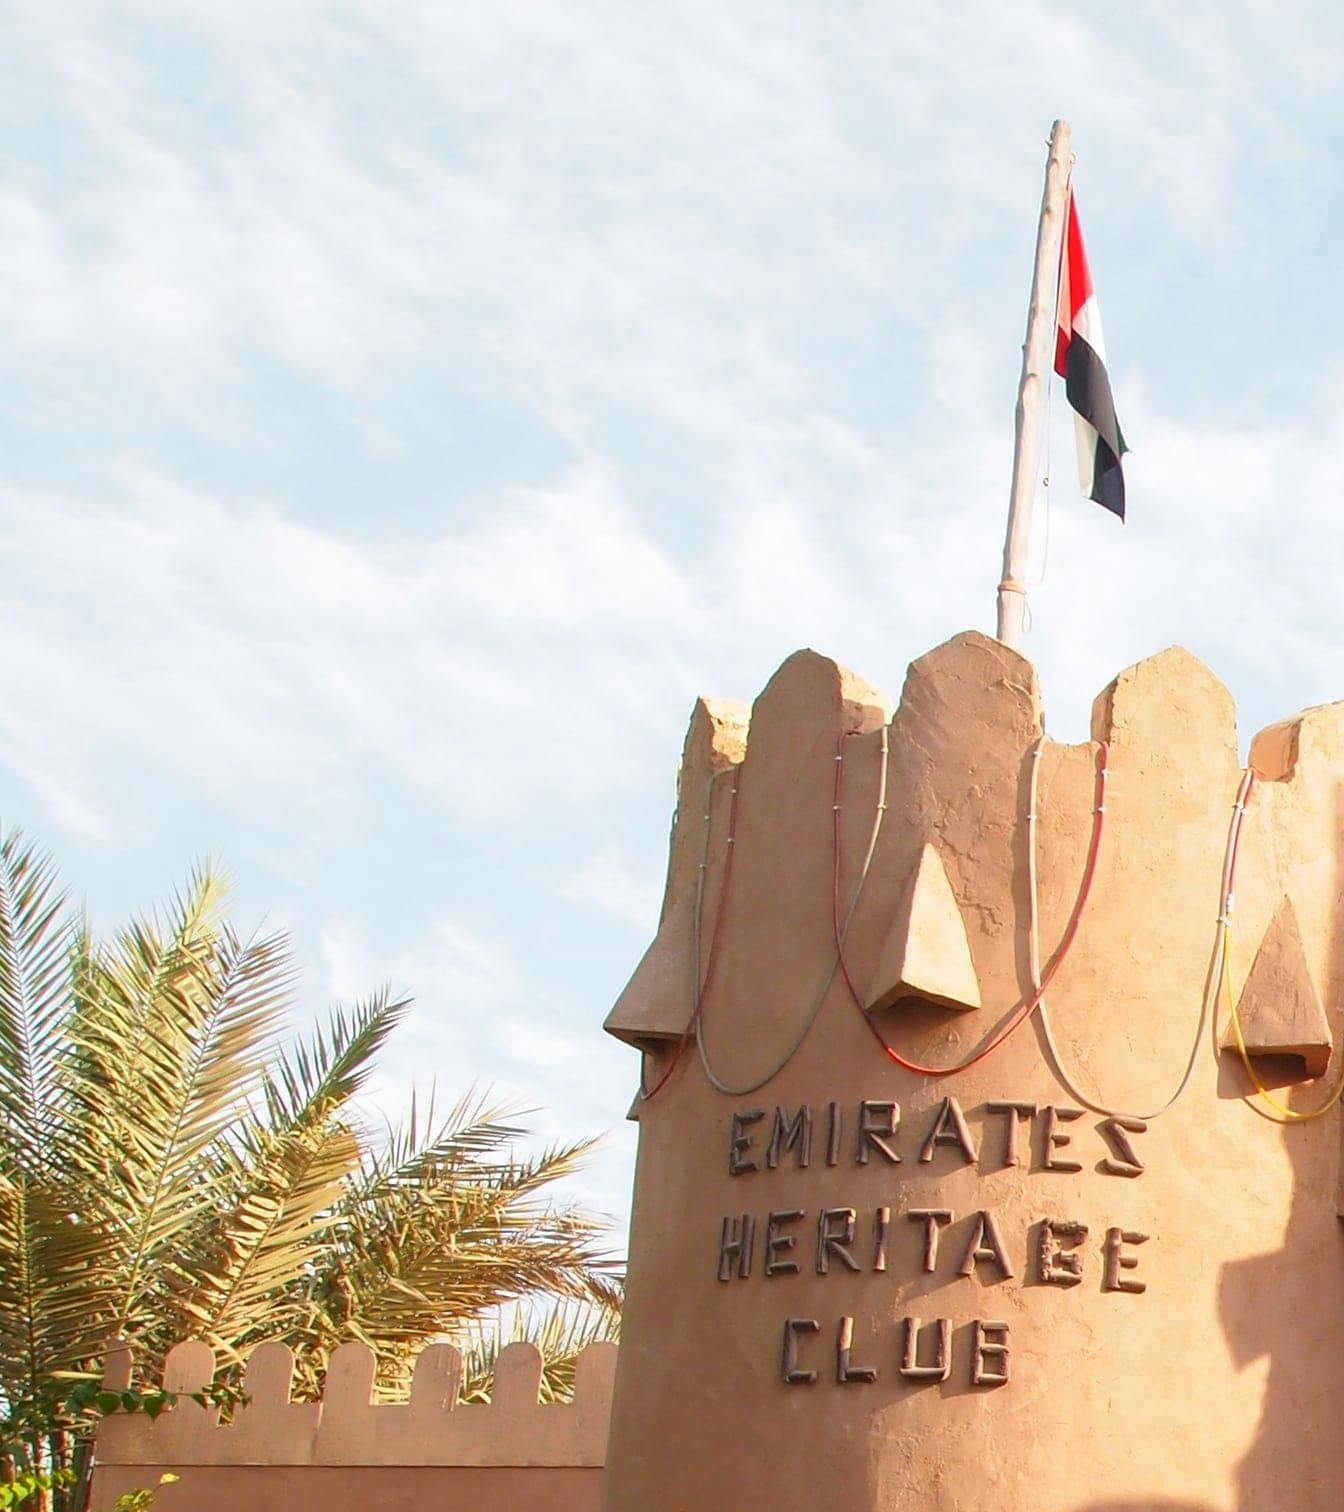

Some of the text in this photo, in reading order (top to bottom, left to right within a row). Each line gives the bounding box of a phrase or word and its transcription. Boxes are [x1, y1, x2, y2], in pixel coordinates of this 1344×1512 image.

[729, 1096, 1148, 1178] EMIRATES
[717, 1206, 1152, 1294] HERITAGE
[780, 1315, 1012, 1387] CLUB
